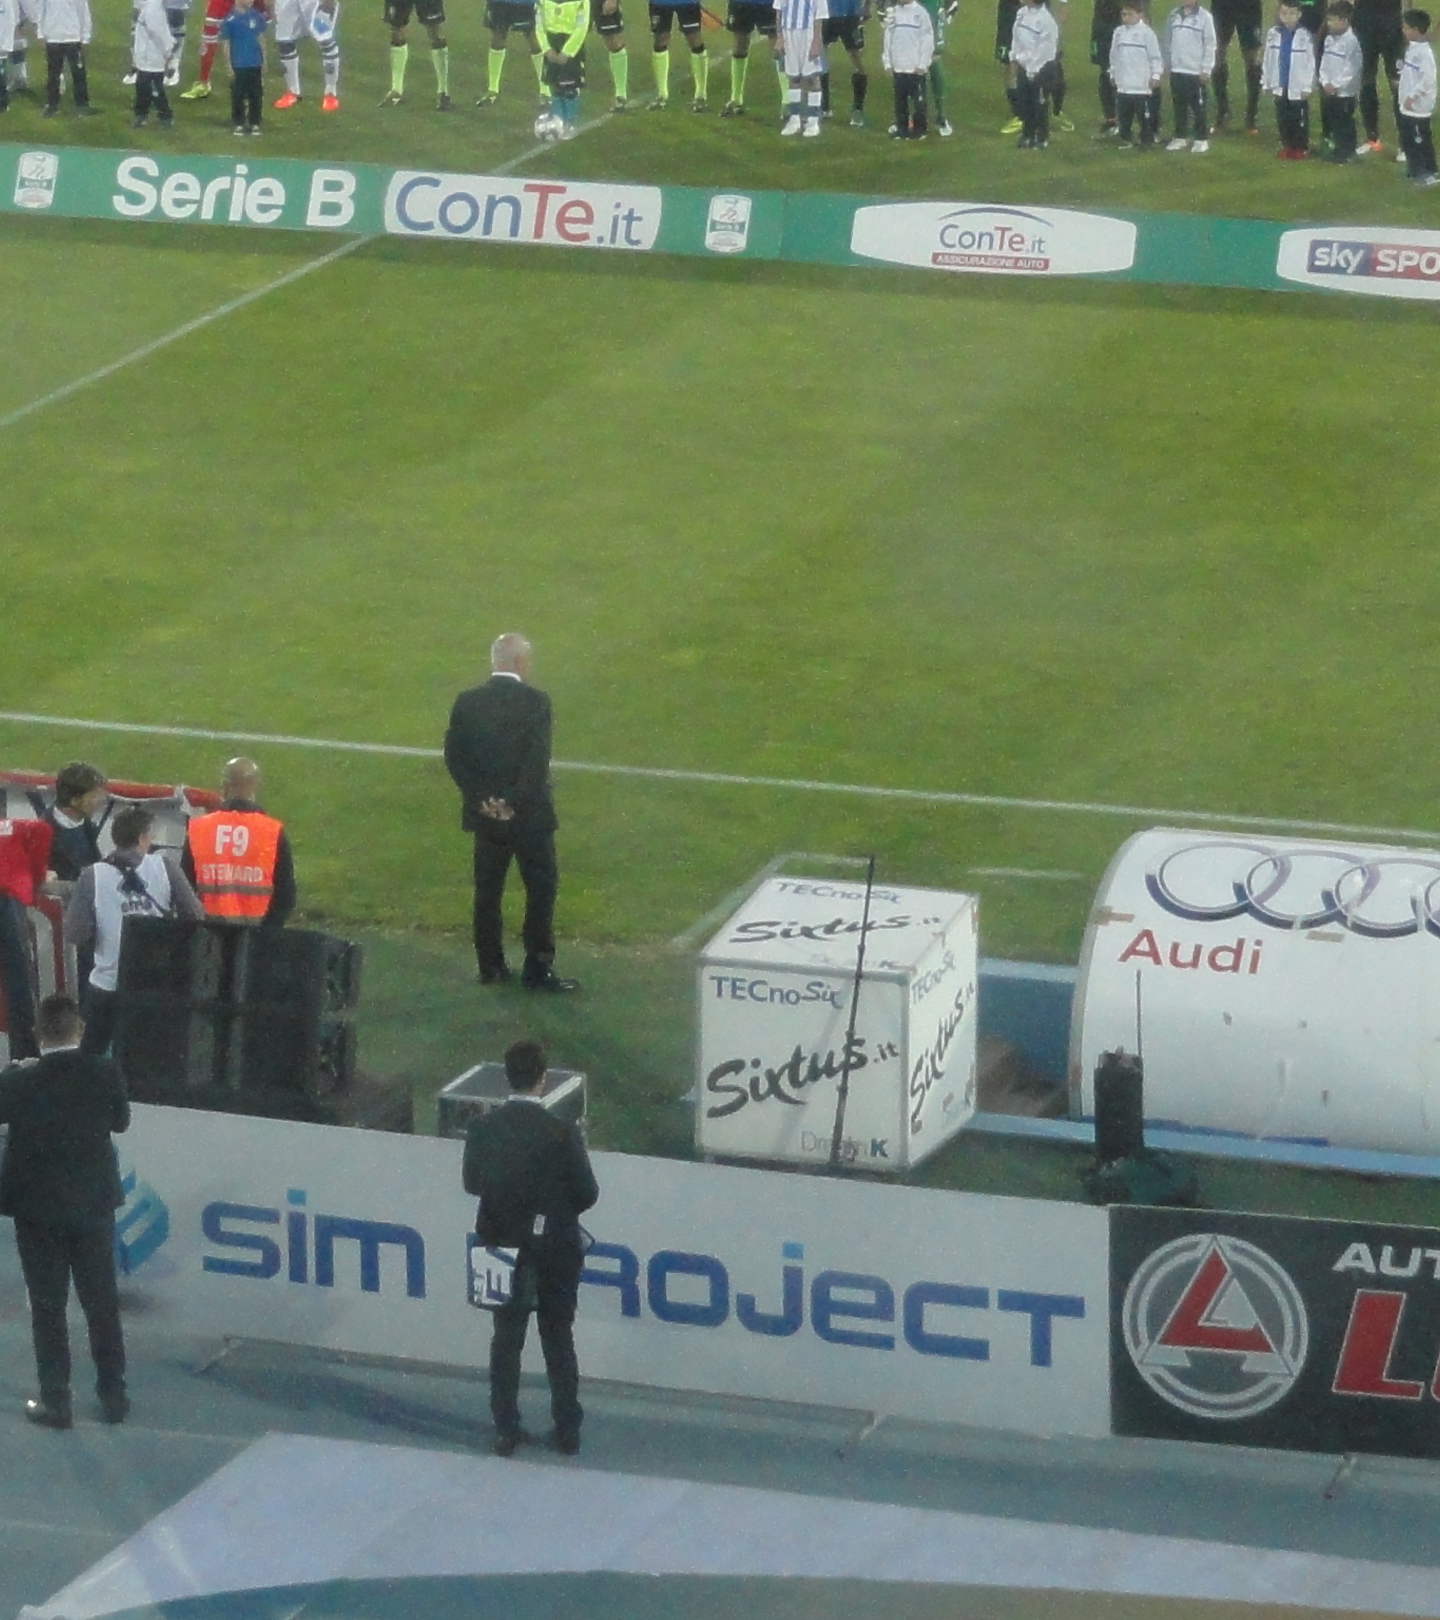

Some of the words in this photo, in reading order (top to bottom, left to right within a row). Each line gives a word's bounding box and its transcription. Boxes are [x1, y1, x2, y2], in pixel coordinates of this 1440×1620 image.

[112, 156, 287, 225] Serie
[306, 168, 357, 228] B
[394, 175, 643, 247] ConTe.it
[937, 222, 1047, 254] ConTe.it
[935, 253, 1015, 269] ASSICURAZIONE
[1017, 258, 1046, 270] AUTO
[1313, 241, 1365, 276] sky
[214, 824, 250, 858] F9
[201, 862, 263, 883] STEWARD
[1117, 928, 1265, 975] Audi
